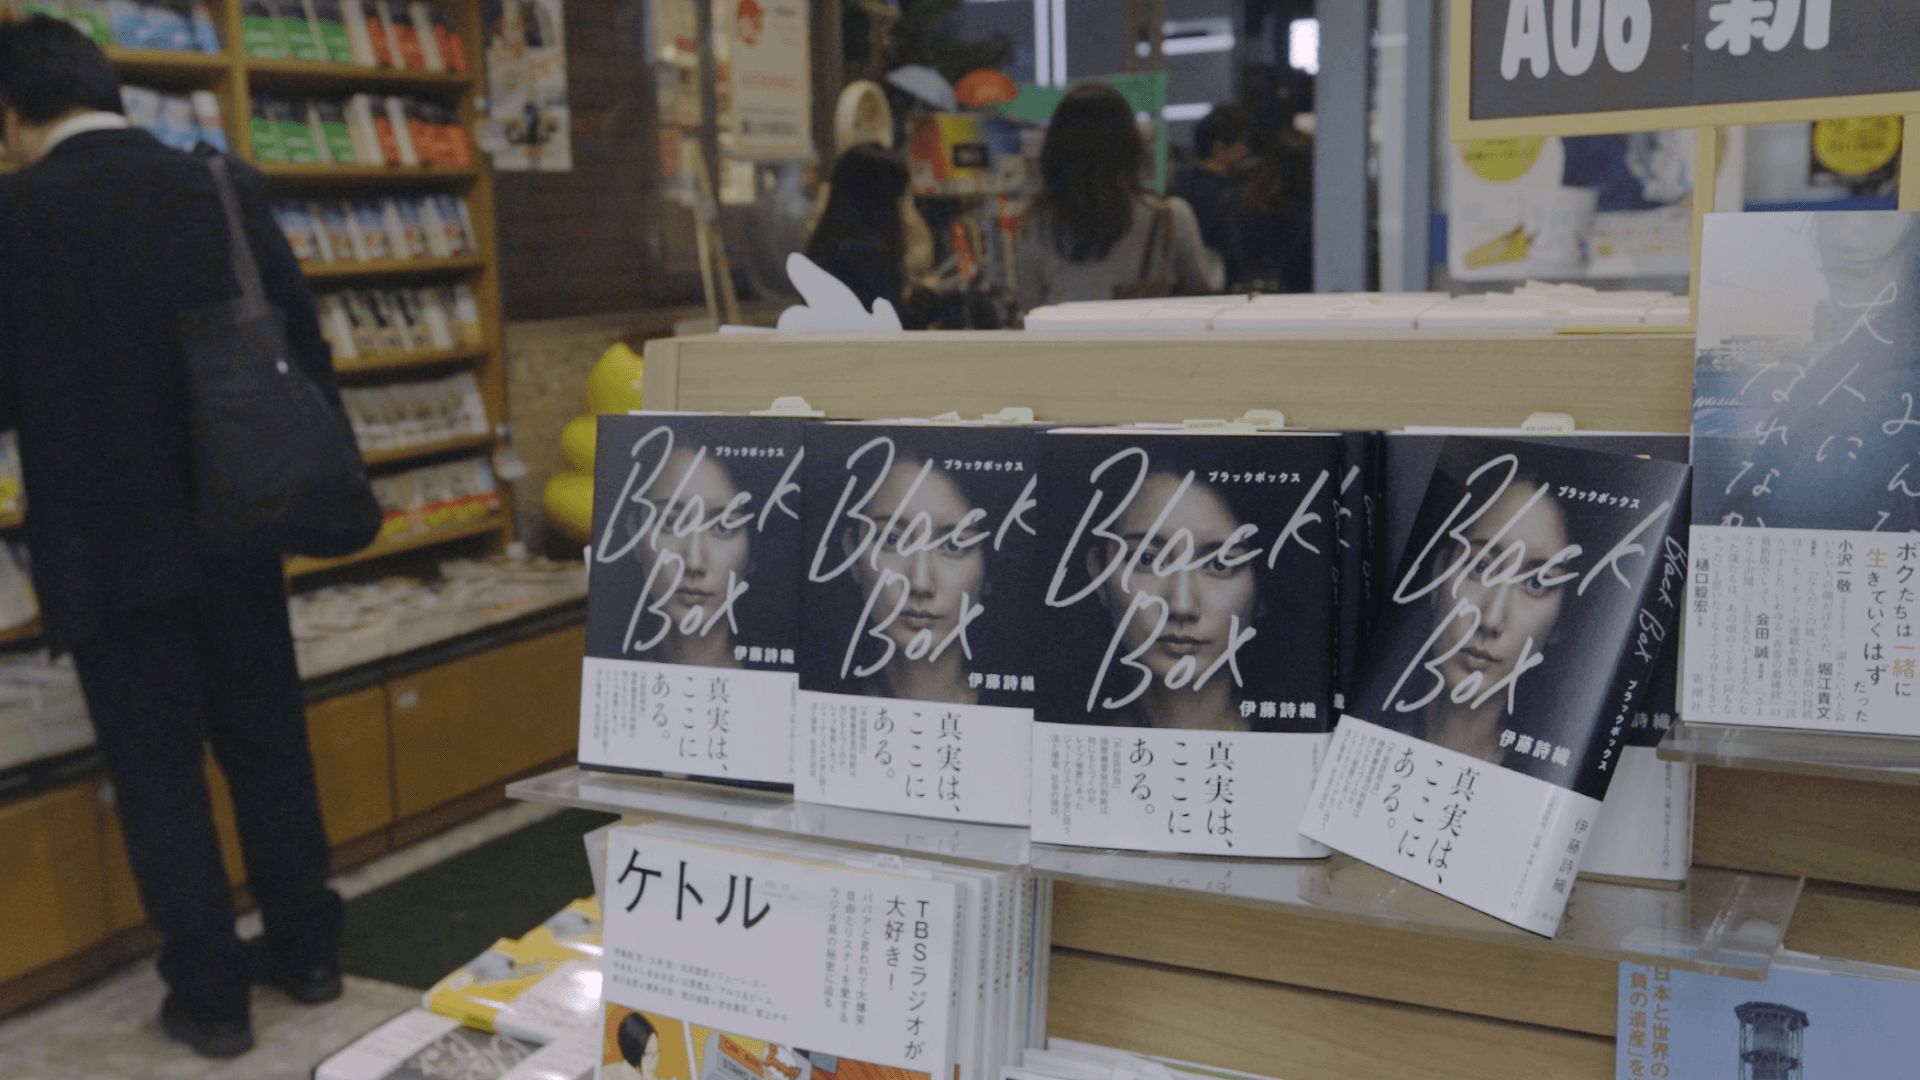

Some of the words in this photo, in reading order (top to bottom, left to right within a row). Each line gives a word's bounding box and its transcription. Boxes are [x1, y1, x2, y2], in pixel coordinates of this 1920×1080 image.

[715, 446, 784, 457] ブラックボックス
[944, 460, 1024, 472] ブラックボックス
[1208, 471, 1301, 484] ブラックボックス
[596, 425, 804, 563] Black
[808, 436, 1037, 583] Black
[1045, 446, 1329, 607] Black
[1392, 453, 1671, 604] Black
[1557, 486, 1640, 510] ブラックボックス
[623, 548, 749, 654] Box
[1658, 536, 1688, 608] Black
[1693, 558, 1709, 613] 樋口毅宏
[1837, 539, 1853, 593] 小沢一敬
[841, 567, 985, 679] Box
[1087, 590, 1257, 713] Box
[1382, 597, 1544, 715] Box
[1635, 608, 1665, 663] Box
[1754, 645, 1769, 659] 誠
[1756, 613, 1770, 640] 会田
[1864, 548, 1888, 686] 生きていくはず
[1892, 541, 1920, 697] ボクたちは一緒に
[651, 671, 670, 740] ある。
[679, 676, 697, 758] ここに
[706, 676, 729, 771] 真実は、
[1239, 700, 1317, 719] 伊藤詩織
[1598, 679, 1638, 771] ブラックボックス
[1816, 662, 1833, 720] 堀江貴文
[1853, 681, 1869, 722] だった
[873, 707, 895, 779] ある。
[905, 712, 925, 798] ここに
[936, 712, 963, 813] 真実は、
[1129, 737, 1155, 815] ある。
[1499, 728, 1571, 767] 伊藤詩織
[1168, 741, 1192, 835] ここに
[1204, 740, 1236, 848] 真実は、
[1383, 747, 1415, 829] ある。
[1397, 759, 1444, 858] ここに
[1426, 766, 1481, 885] 真実は、
[617, 848, 771, 930] ケトル
[1551, 818, 1588, 894] 伊藤詩織
[885, 895, 906, 991] 大好き！
[905, 900, 930, 1060] TBSラジオが
[1650, 965, 1671, 1079] 日本と世界の
